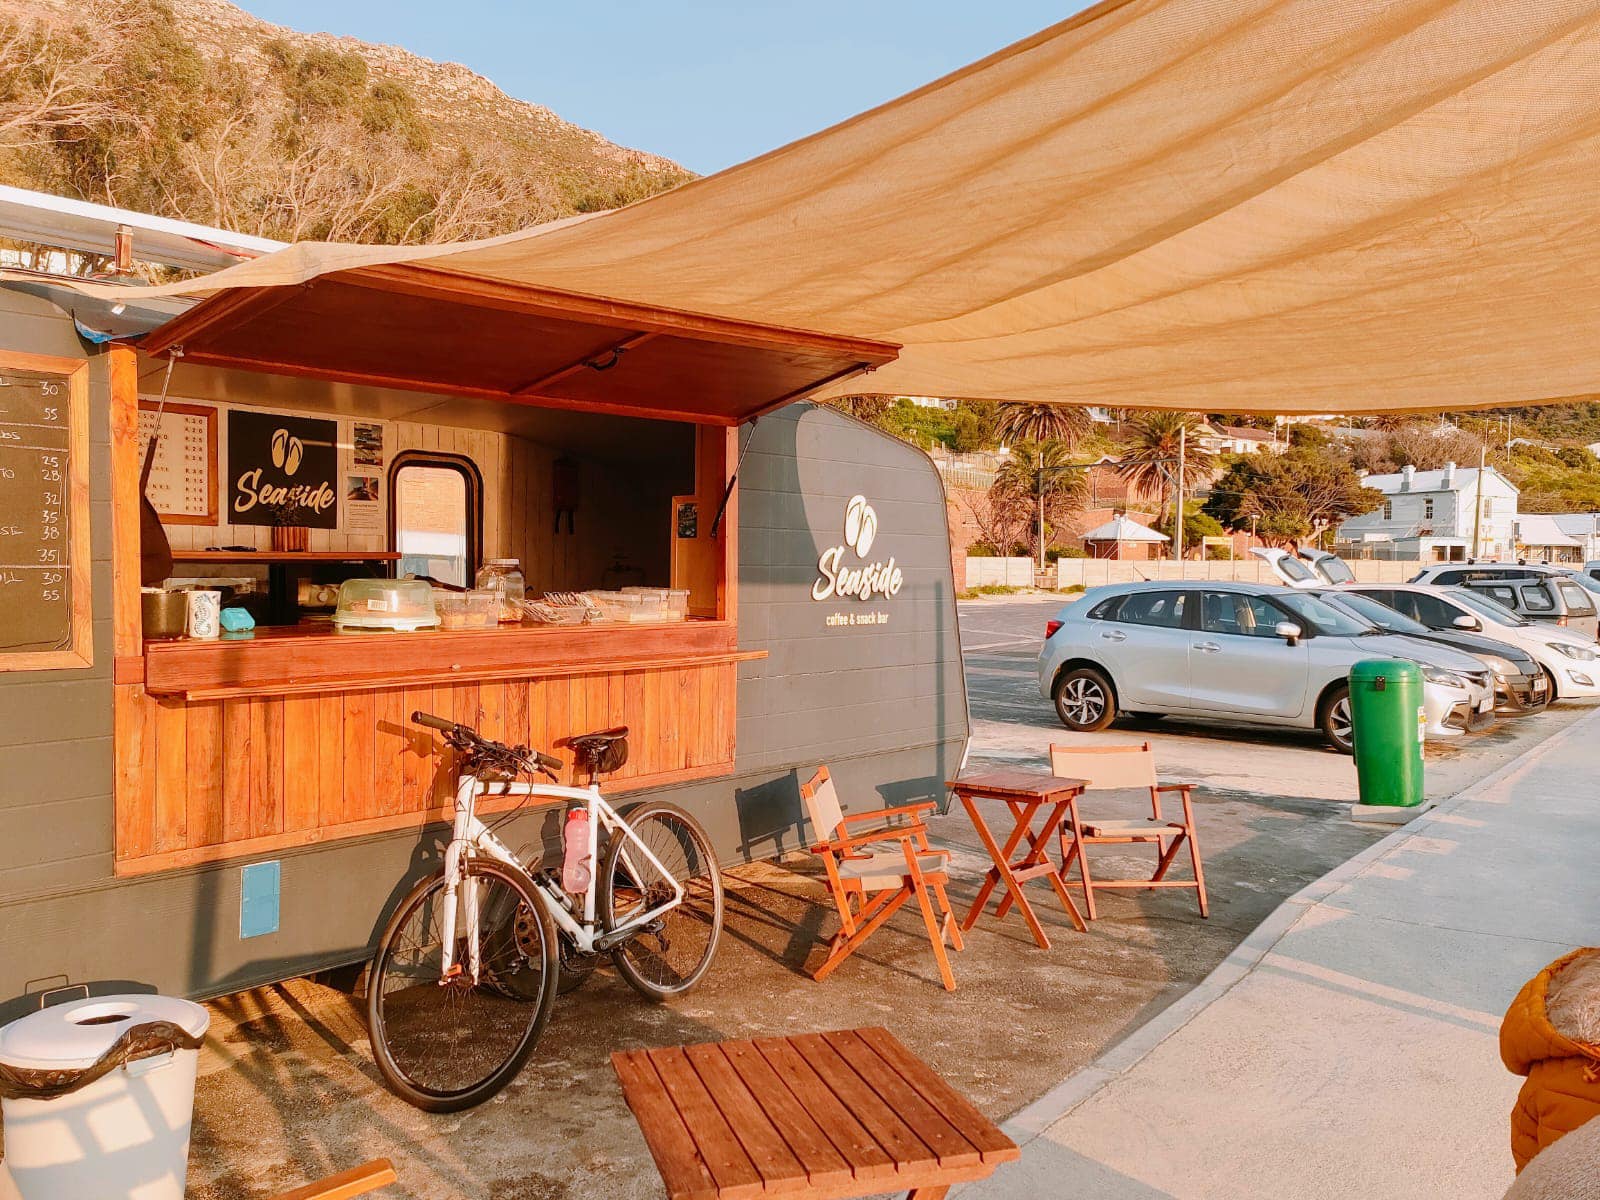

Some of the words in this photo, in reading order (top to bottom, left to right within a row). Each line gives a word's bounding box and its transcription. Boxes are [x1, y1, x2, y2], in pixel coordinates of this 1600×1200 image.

[39, 381, 59, 396] 30
[43, 407, 58, 421] 55
[41, 455, 59, 468] 25
[41, 469, 60, 481] 28
[43, 492, 60, 505] 32
[41, 510, 58, 524] 35
[40, 525, 60, 540] 38
[36, 548, 57, 562] 35
[41, 572, 62, 585] 30
[812, 545, 903, 601] Seaside
[42, 589, 60, 601] 55
[826, 612, 849, 626] coffee
[849, 612, 855, 625] &
[856, 611, 876, 625] snack
[877, 611, 889, 624] bar
